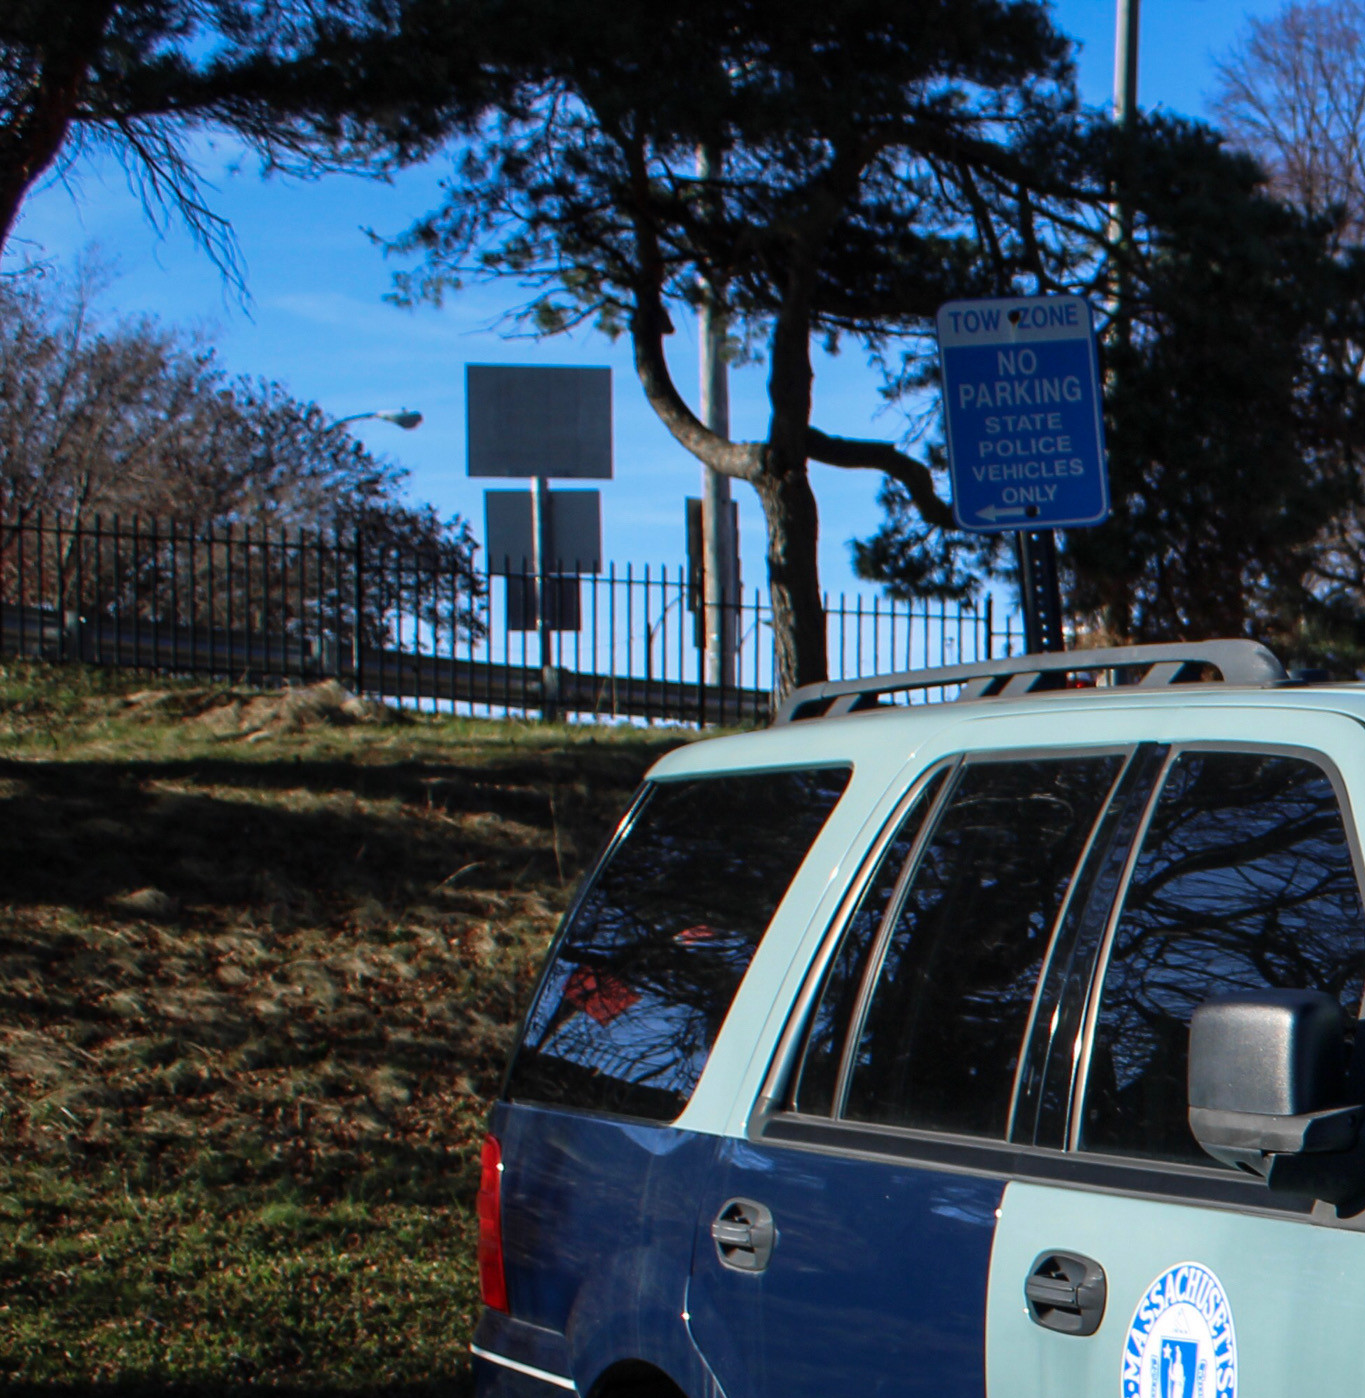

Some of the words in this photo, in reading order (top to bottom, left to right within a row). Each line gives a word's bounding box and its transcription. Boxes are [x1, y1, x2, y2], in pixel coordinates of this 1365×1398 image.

[949, 309, 1001, 334] TOW
[1017, 303, 1079, 329] ZONE
[997, 348, 1037, 376] NO
[959, 375, 1082, 409] PARKING
[985, 412, 1063, 434] STATE
[978, 435, 1073, 458] POLICE
[972, 458, 1084, 482] VEHICLES
[1001, 483, 1058, 504] ONLY
[1123, 1266, 1234, 1391] MASSACHUSETTS
